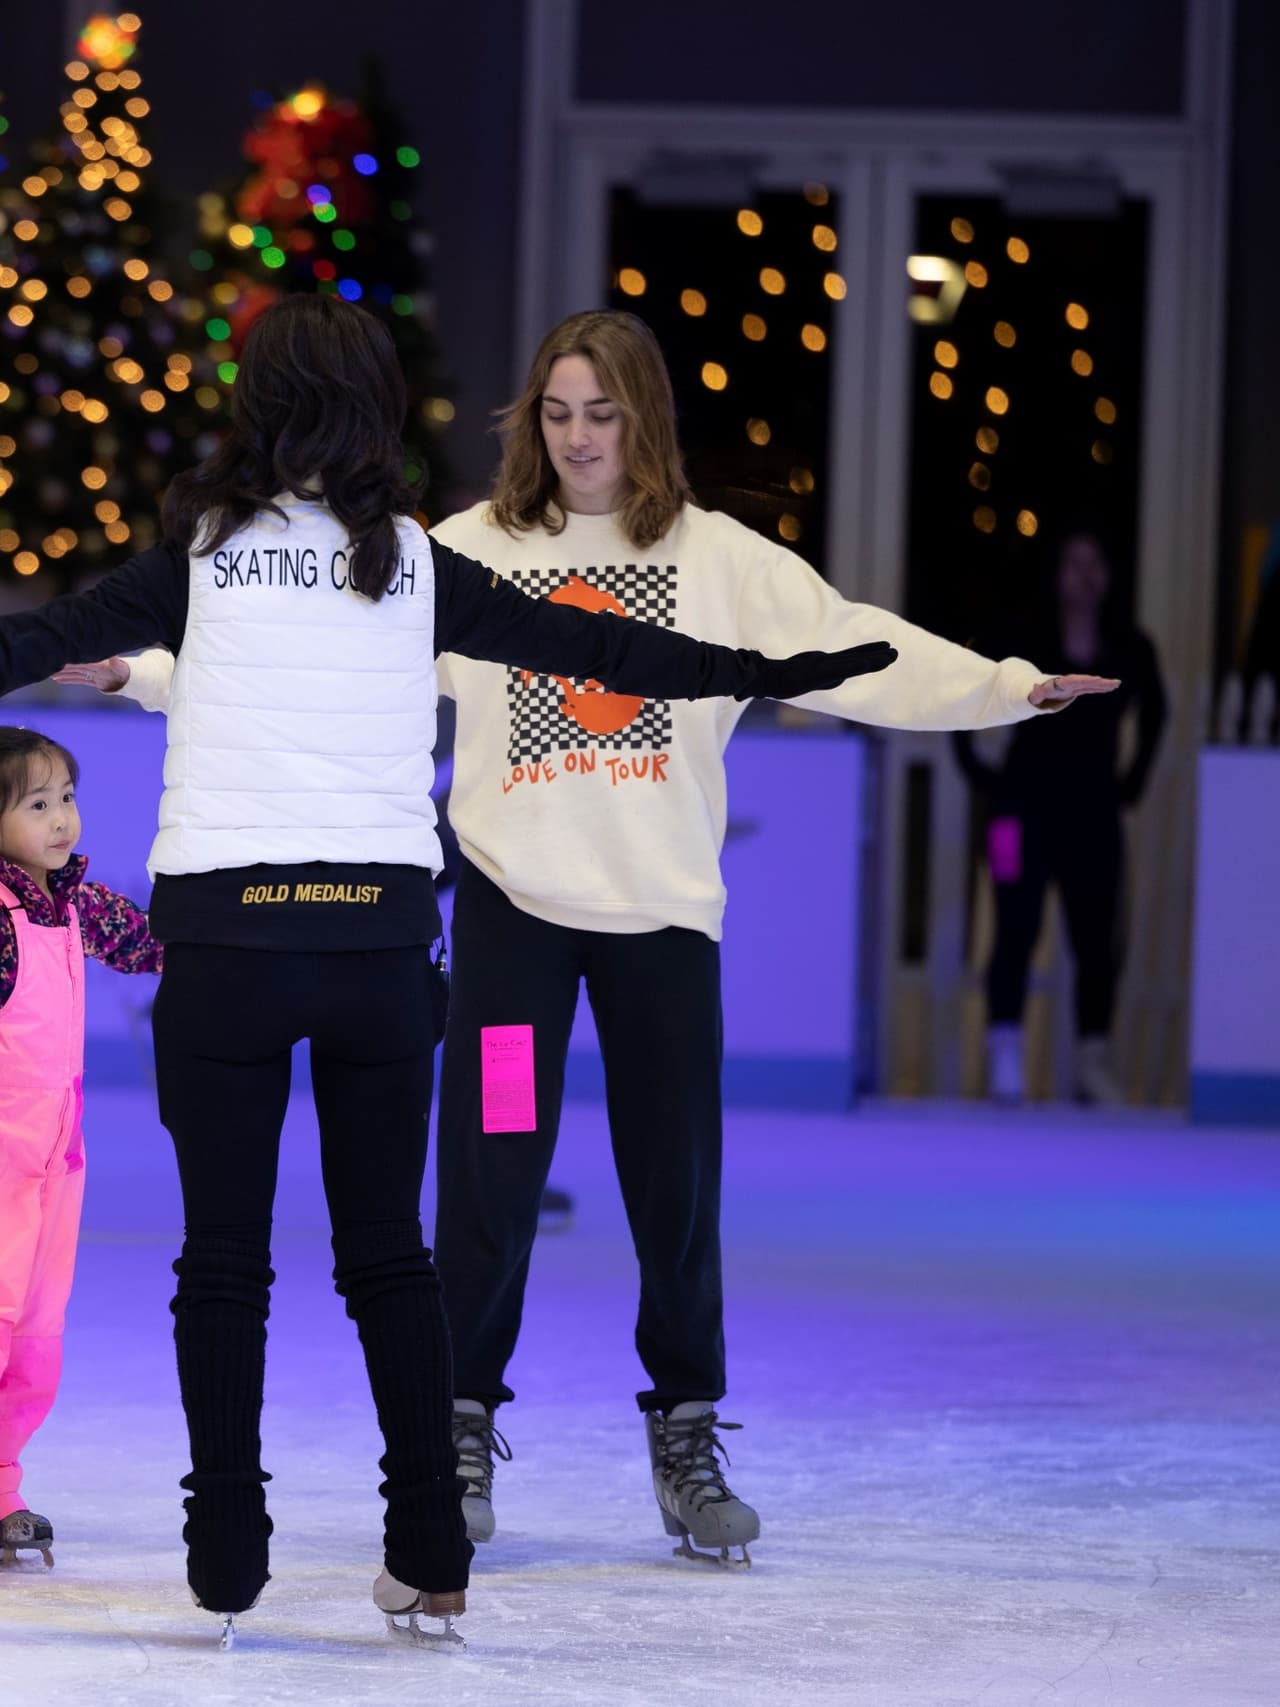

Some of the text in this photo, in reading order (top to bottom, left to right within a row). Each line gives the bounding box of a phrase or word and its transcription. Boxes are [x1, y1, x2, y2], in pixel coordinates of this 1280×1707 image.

[214, 548, 415, 596] SKATING COH
[502, 749, 669, 794] LOVE ON TOUR
[242, 884, 383, 904] GOLD MEDALIST
